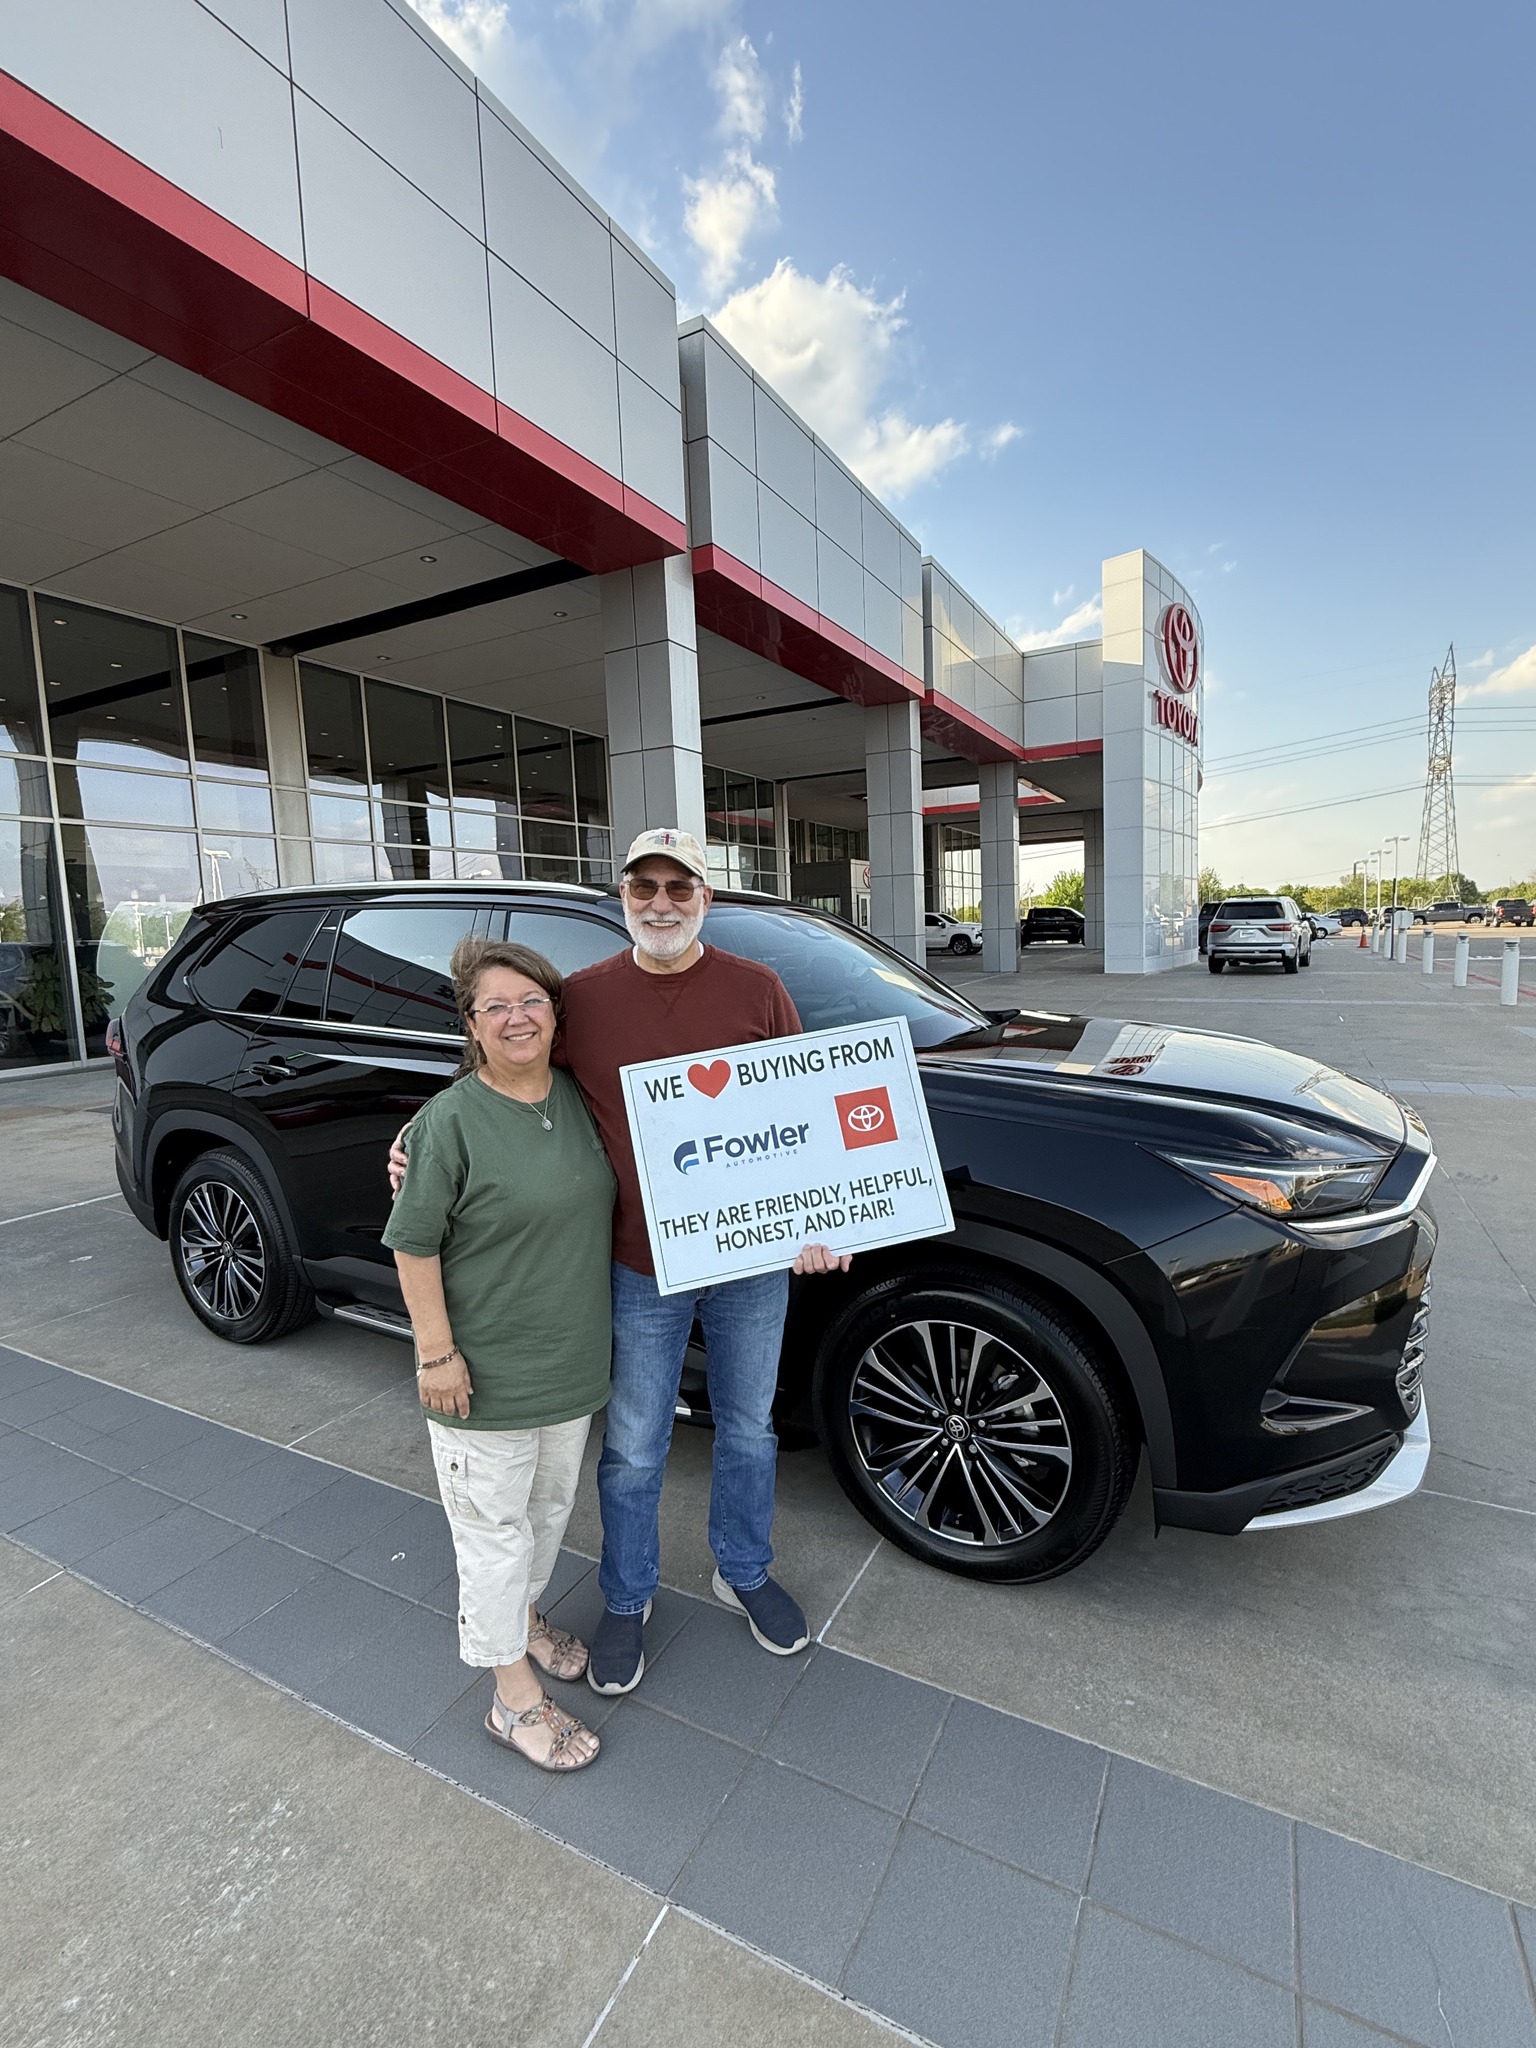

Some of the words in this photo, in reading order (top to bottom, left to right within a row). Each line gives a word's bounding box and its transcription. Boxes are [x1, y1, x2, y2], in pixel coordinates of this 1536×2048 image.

[644, 1075, 685, 1103] WE
[736, 1049, 825, 1086] BUYING
[828, 1036, 895, 1069] FROM
[703, 1122, 810, 1163] Fowler
[725, 1149, 799, 1168] AUTOMOTIVE
[659, 1211, 710, 1239] THEY
[716, 1203, 752, 1229] ARE
[754, 1183, 846, 1219] FRIENDLY,
[848, 1166, 932, 1199] HELPFUL,
[715, 1218, 800, 1253] HONEST,
[804, 1208, 846, 1235] AND
[848, 1197, 895, 1224] FAIR!
